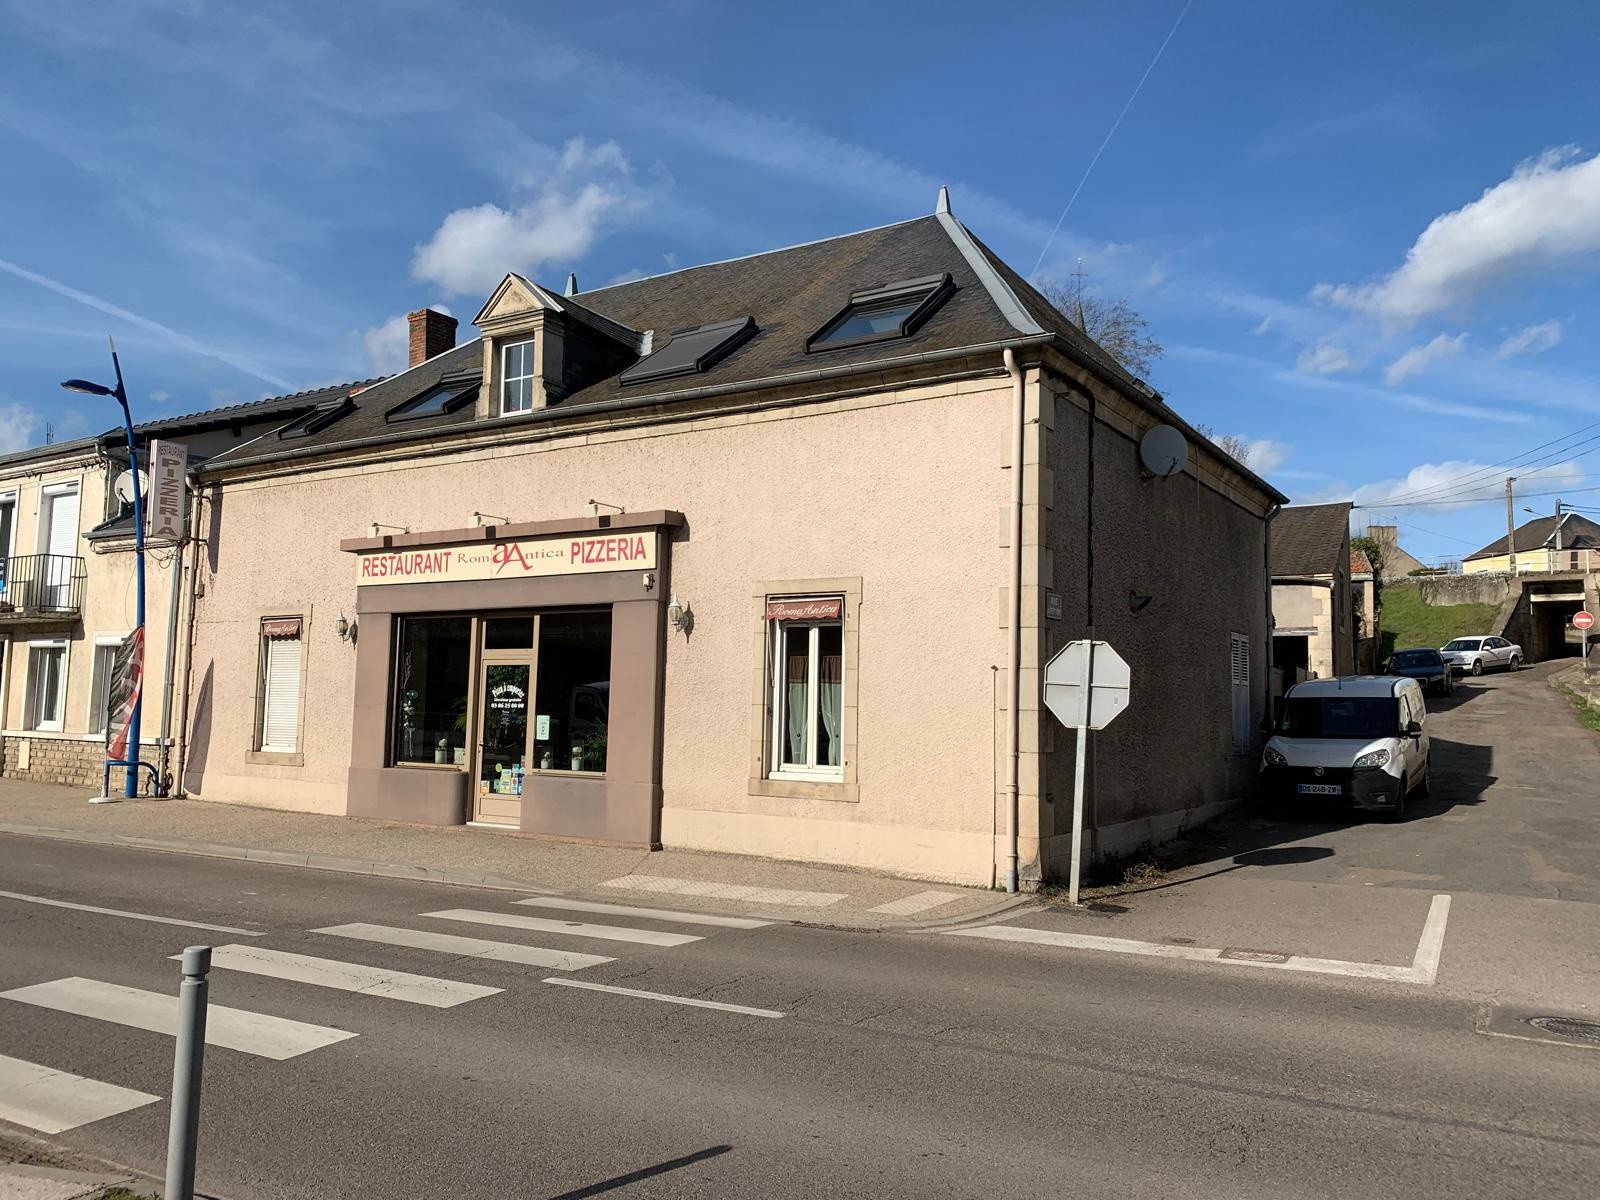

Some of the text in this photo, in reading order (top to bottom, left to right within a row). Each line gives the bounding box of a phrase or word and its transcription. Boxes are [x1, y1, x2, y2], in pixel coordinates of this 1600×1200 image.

[156, 458, 180, 536] PIZZERIA
[362, 551, 452, 577] RESTAURANT
[571, 536, 646, 564] PIZZERIA
[769, 603, 838, 616] Roma Antica
